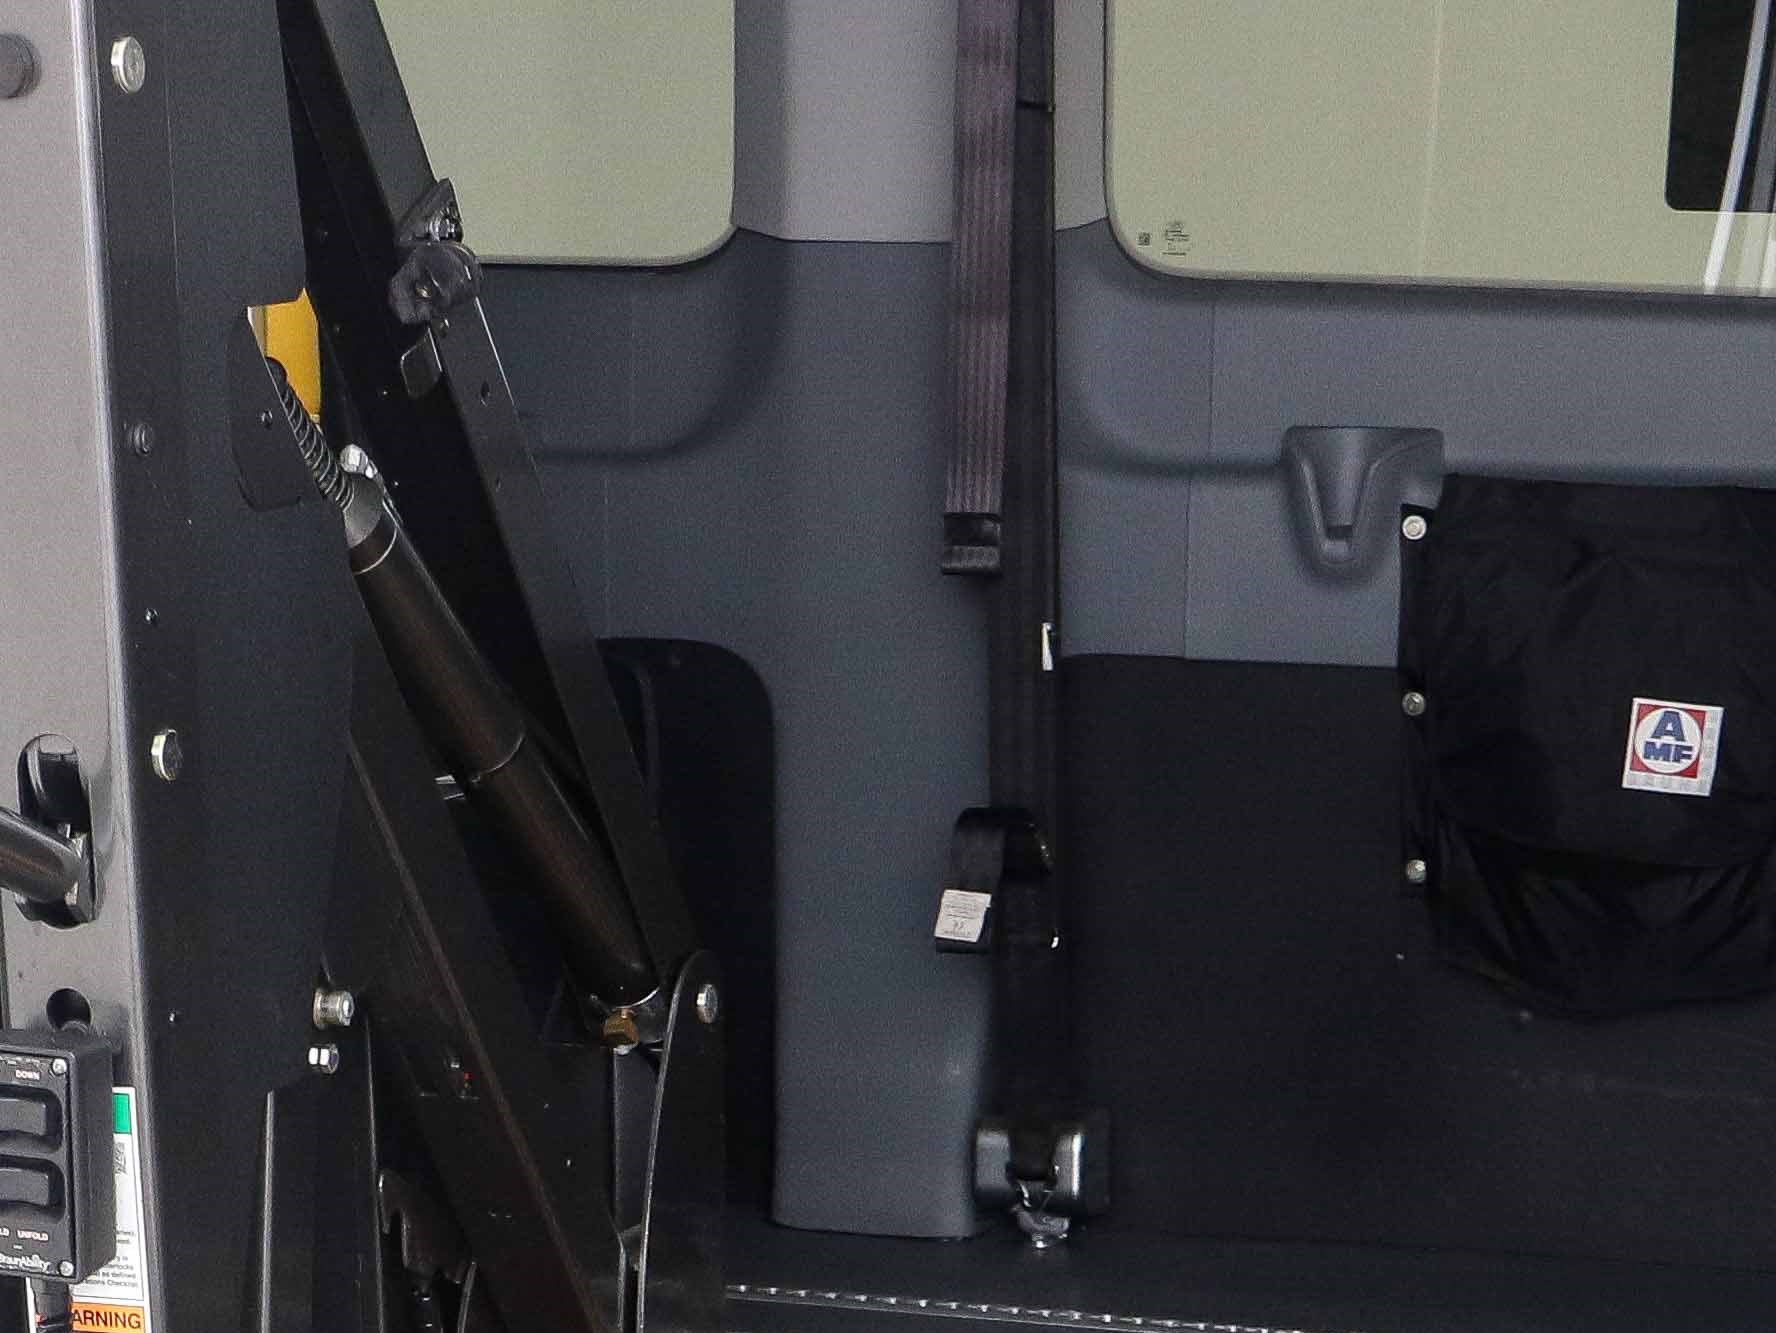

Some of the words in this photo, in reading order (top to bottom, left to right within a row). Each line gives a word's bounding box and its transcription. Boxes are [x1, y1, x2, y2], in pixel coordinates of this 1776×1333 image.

[1651, 710, 1687, 742] A
[1643, 741, 1694, 764] MF
[15, 1069, 41, 1081] DOWN
[16, 1230, 49, 1242] UNFOLD
[71, 1308, 142, 1330] ARNING
